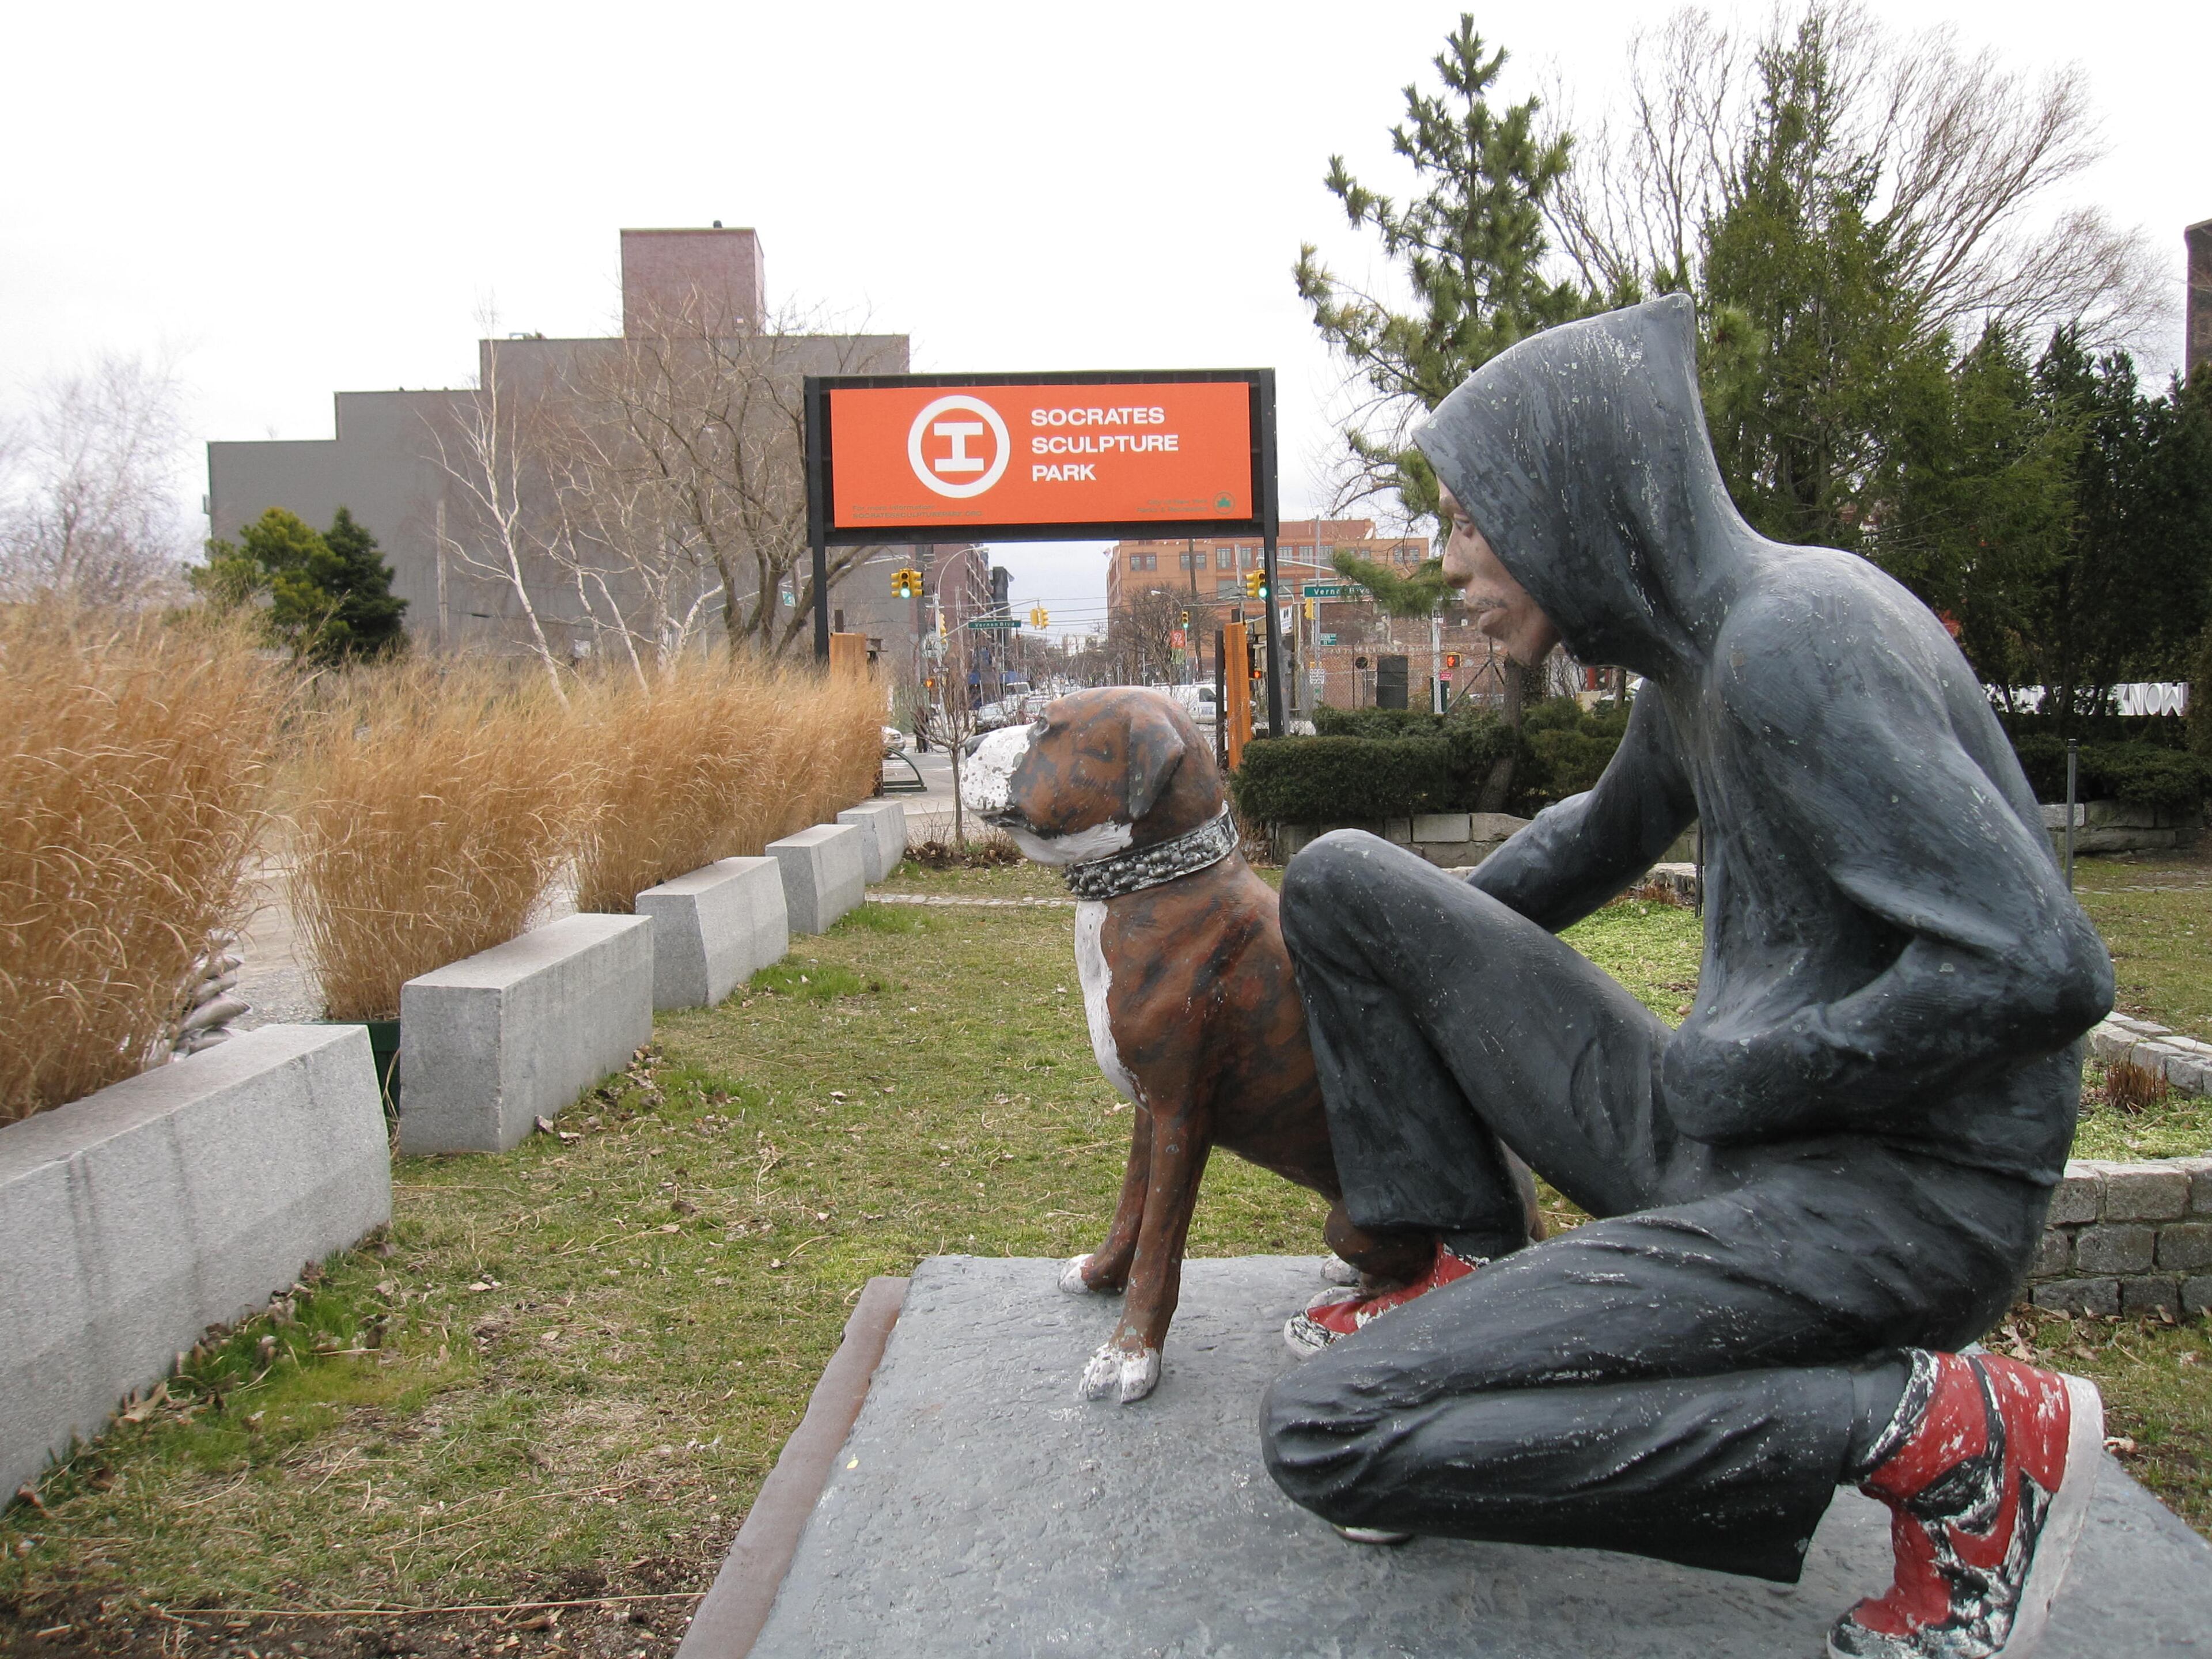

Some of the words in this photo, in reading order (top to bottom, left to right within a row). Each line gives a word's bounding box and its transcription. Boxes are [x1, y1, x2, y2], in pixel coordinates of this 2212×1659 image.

[1031, 407, 1165, 426] SOCRATES
[1032, 434, 1179, 454] SCULPTURE
[1032, 463, 1096, 482] PARK
